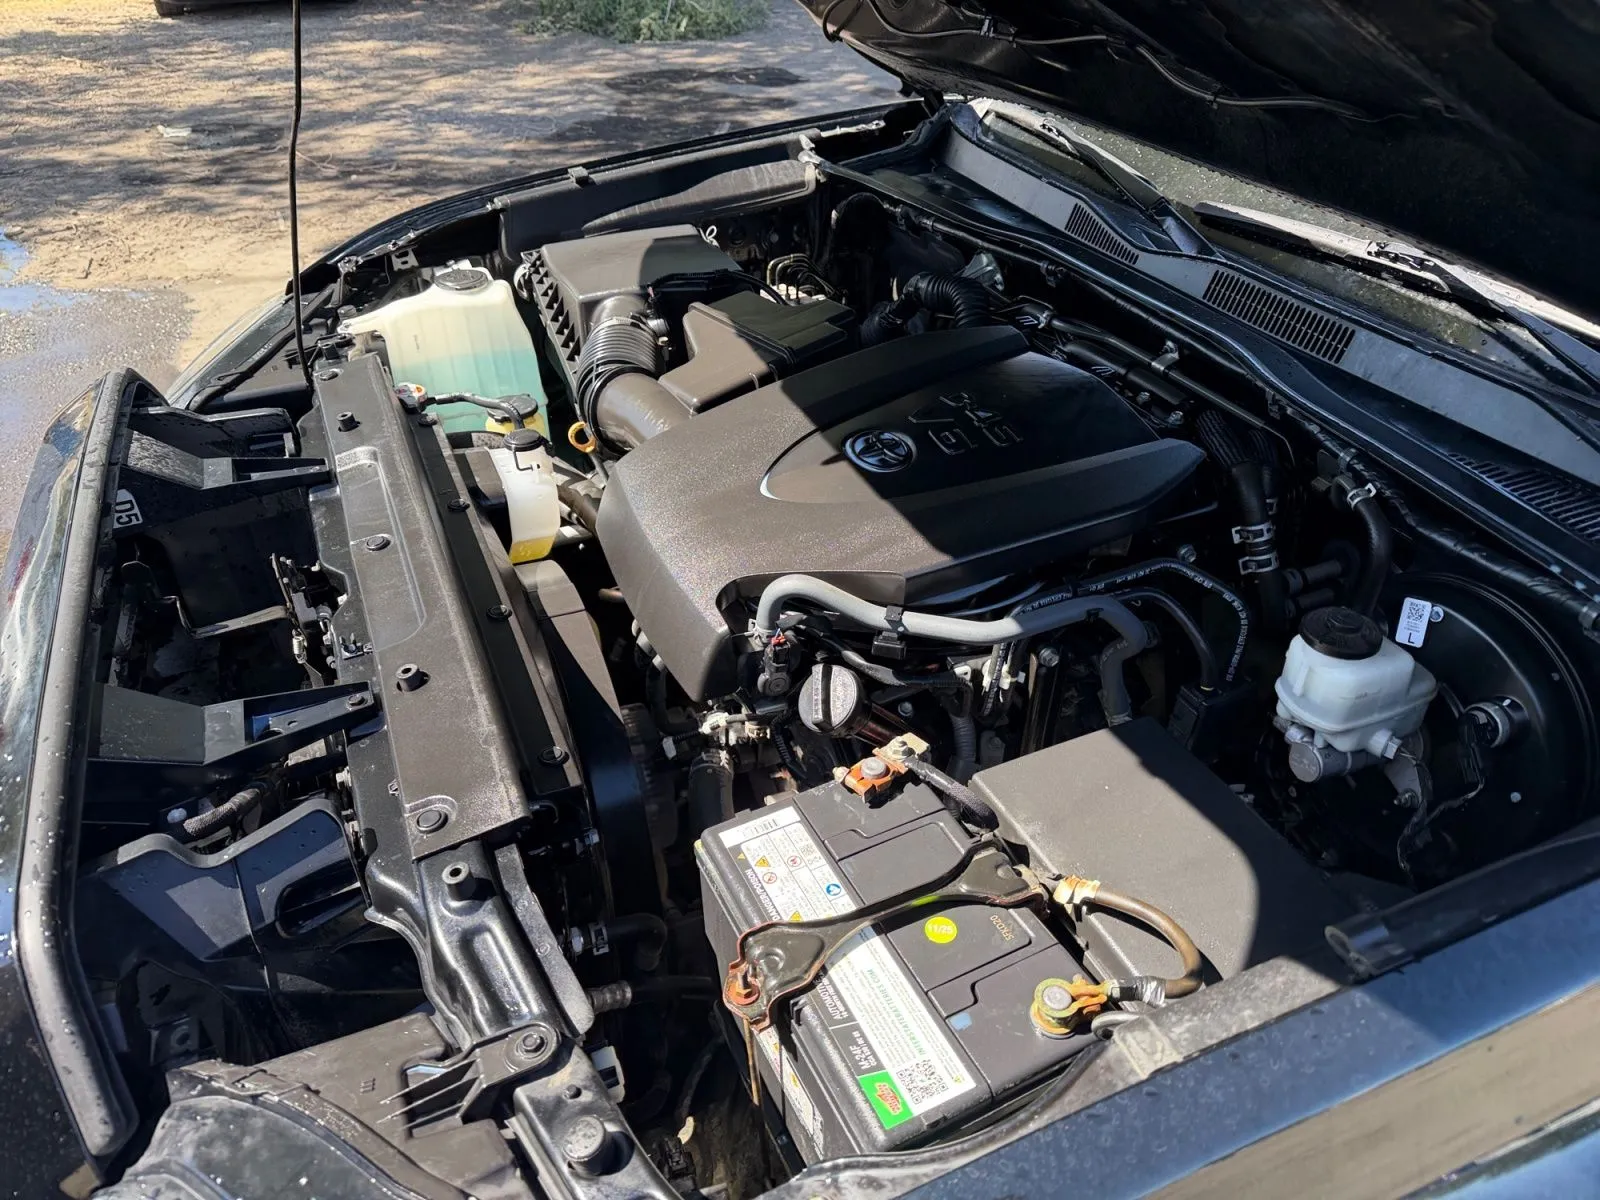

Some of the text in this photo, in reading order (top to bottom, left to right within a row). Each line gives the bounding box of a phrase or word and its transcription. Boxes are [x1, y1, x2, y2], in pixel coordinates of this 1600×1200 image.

[1408, 633, 1416, 645] L
[744, 867, 781, 921] DANGER/POISON
[848, 1044, 871, 1070] M-24F
